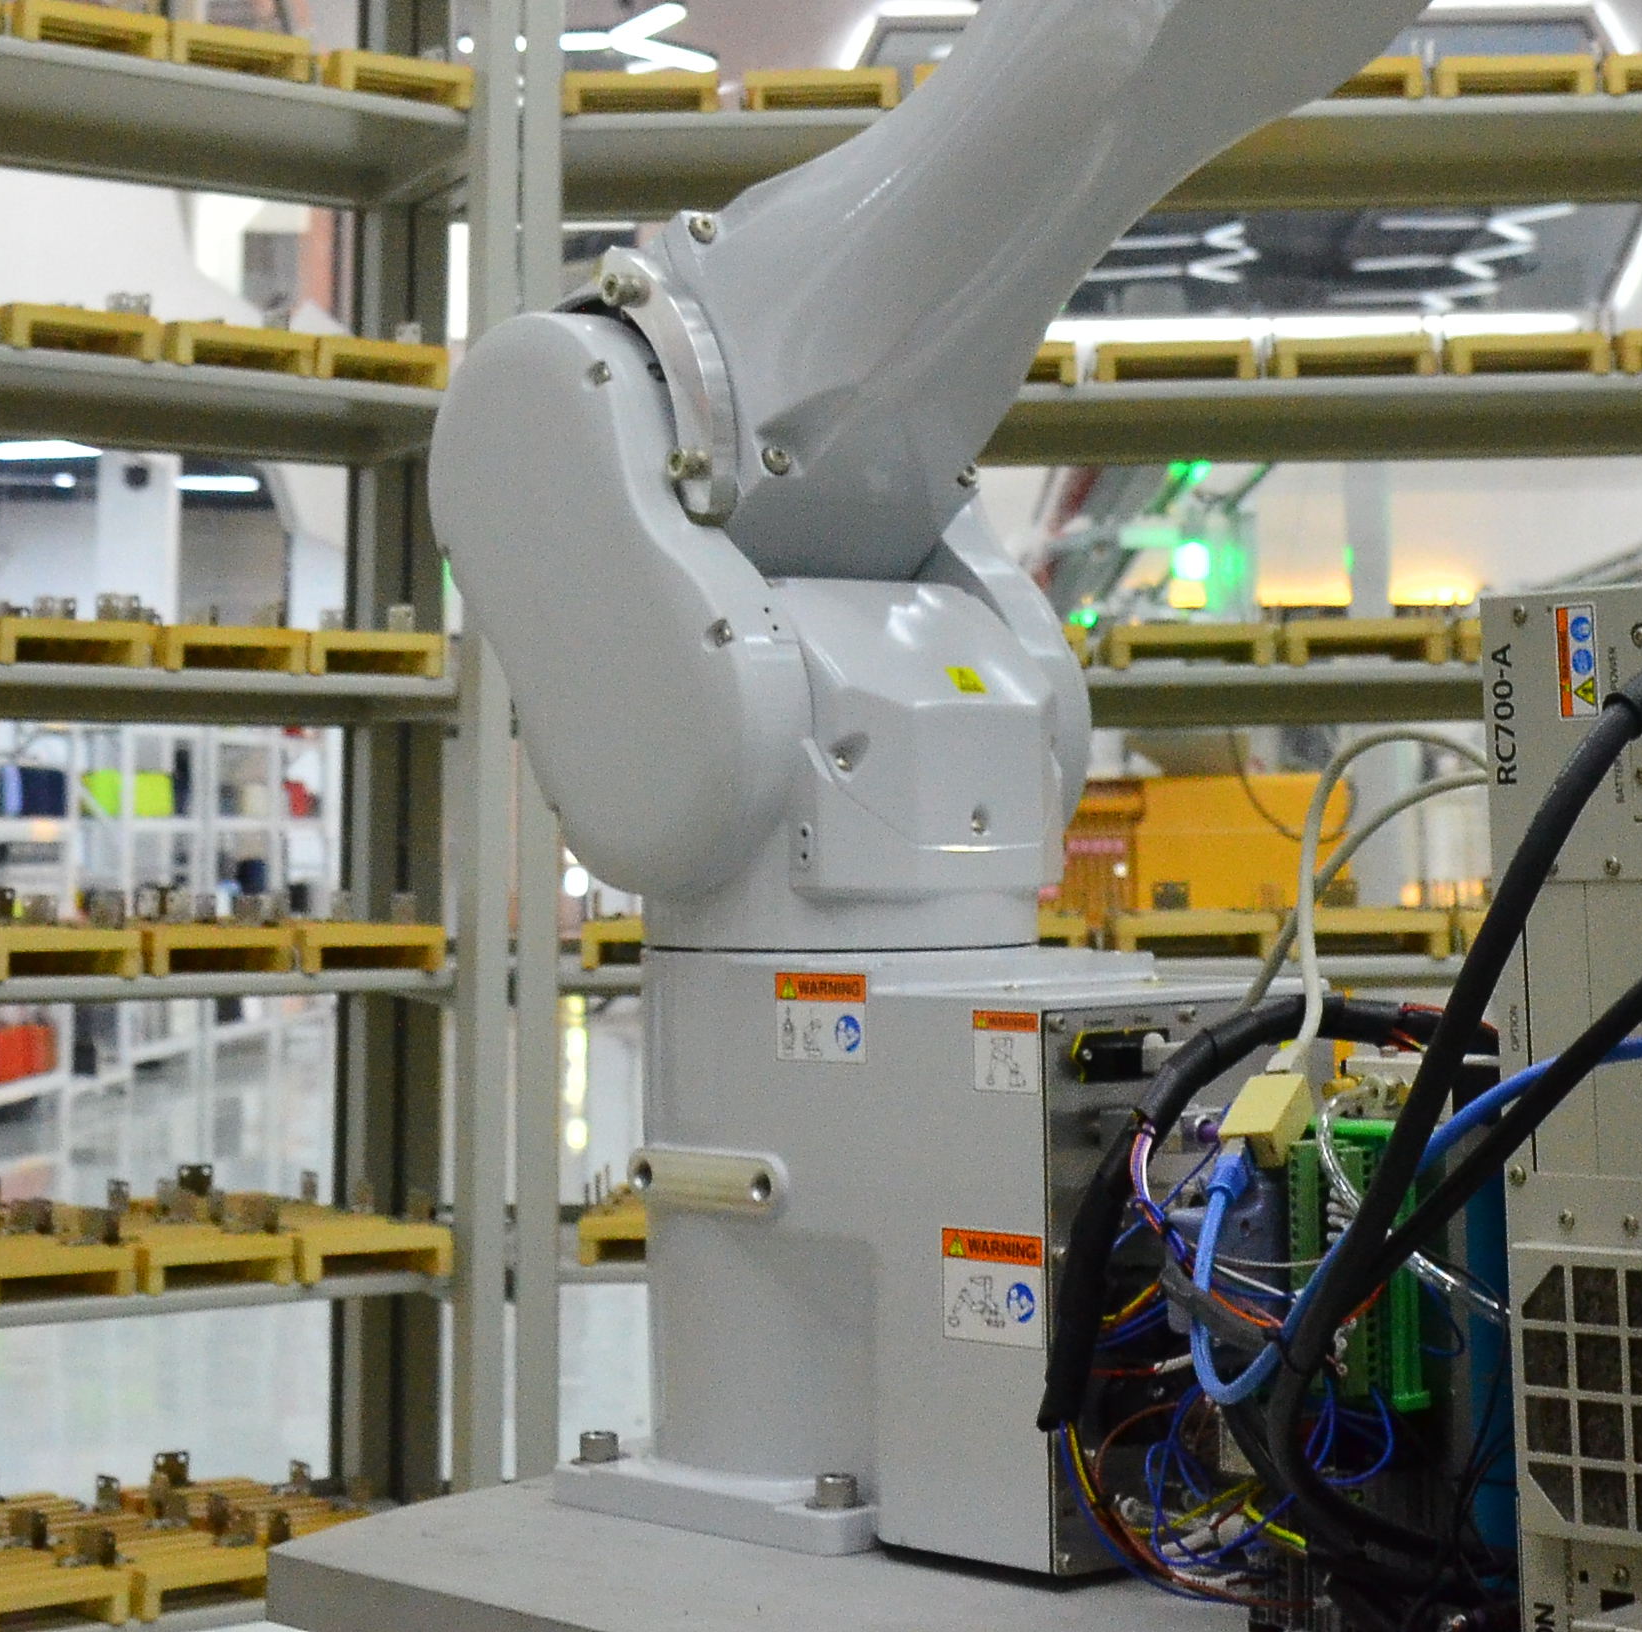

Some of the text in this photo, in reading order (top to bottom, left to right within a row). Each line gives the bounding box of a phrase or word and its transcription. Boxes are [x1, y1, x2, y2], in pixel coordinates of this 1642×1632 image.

[1608, 646, 1619, 692] POWER
[1491, 643, 1518, 786] RC700-A
[1613, 757, 1625, 804] BATTER
[798, 980, 861, 999] WARNING
[1509, 1005, 1521, 1052] OPTION
[967, 1237, 1038, 1261] WARNING
